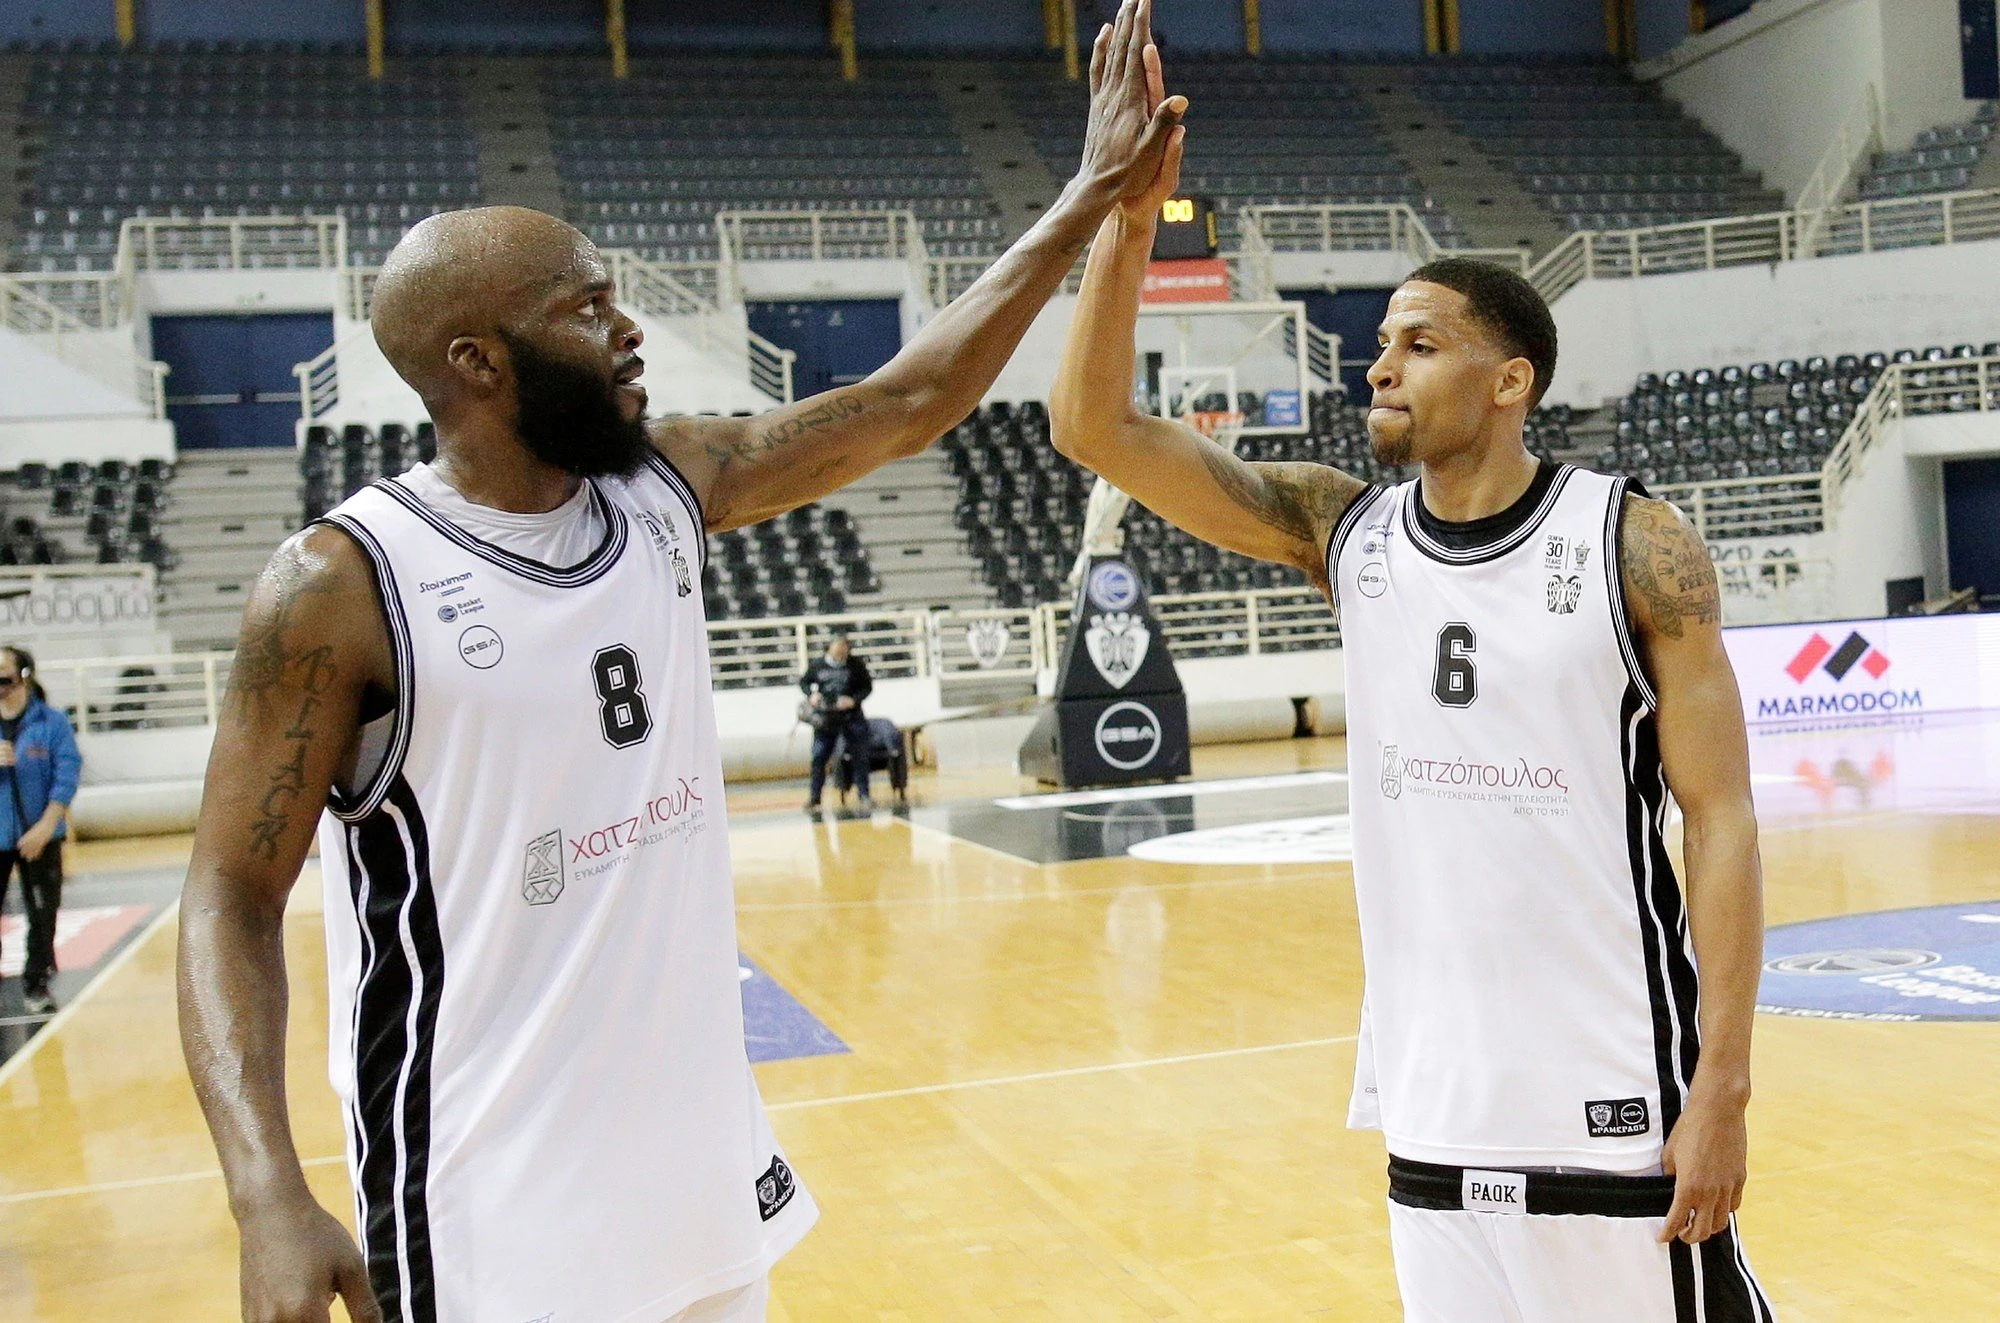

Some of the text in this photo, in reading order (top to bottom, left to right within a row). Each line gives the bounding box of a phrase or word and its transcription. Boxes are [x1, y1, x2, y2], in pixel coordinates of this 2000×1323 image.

[1546, 541, 1563, 558] 30
[419, 572, 473, 593] Stoiximan
[463, 638, 499, 655] GSA
[1431, 621, 1478, 708] 6
[591, 643, 654, 750] 8
[1757, 689, 1923, 718] MARMODOM
[1400, 755, 1568, 794] χατζόπουλος
[1471, 1182, 1517, 1203] PAOK
